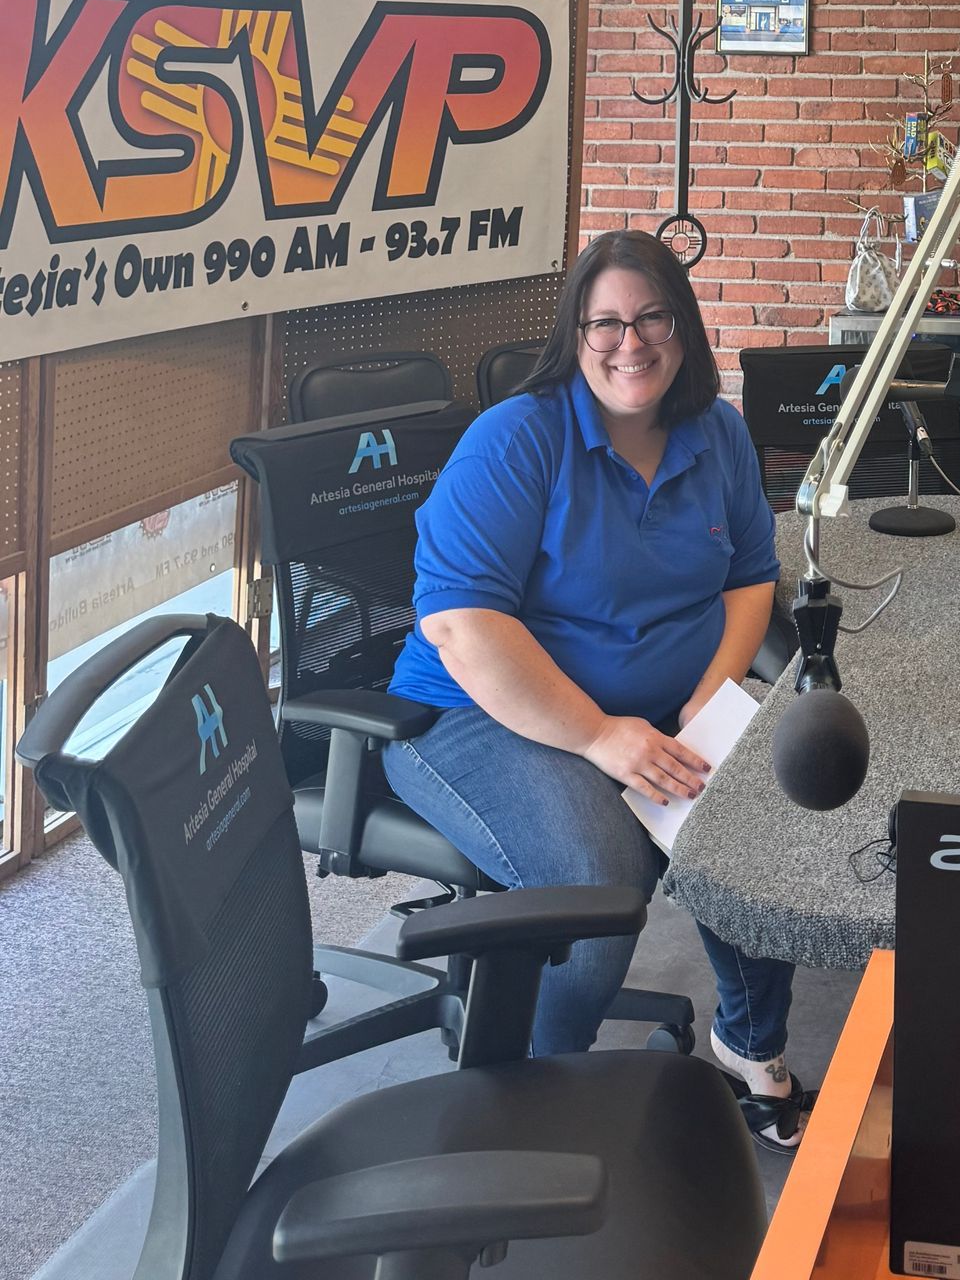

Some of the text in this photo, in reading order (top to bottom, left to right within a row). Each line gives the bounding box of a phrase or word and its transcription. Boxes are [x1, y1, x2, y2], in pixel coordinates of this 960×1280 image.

[114, 243, 195, 299] Own
[203, 236, 277, 285] 990
[283, 222, 351, 275] AM
[359, 236, 376, 254] -
[386, 217, 461, 261] 93.7
[467, 206, 524, 251] FM
[778, 402, 816, 413] Artesia
[348, 429, 398, 474] AH
[310, 468, 440, 505] Artesia General Hospital
[339, 491, 419, 515] artesiageneral.com
[183, 738, 258, 846] Artesia General Hospital
[205, 786, 252, 851] artesiageneral.com
